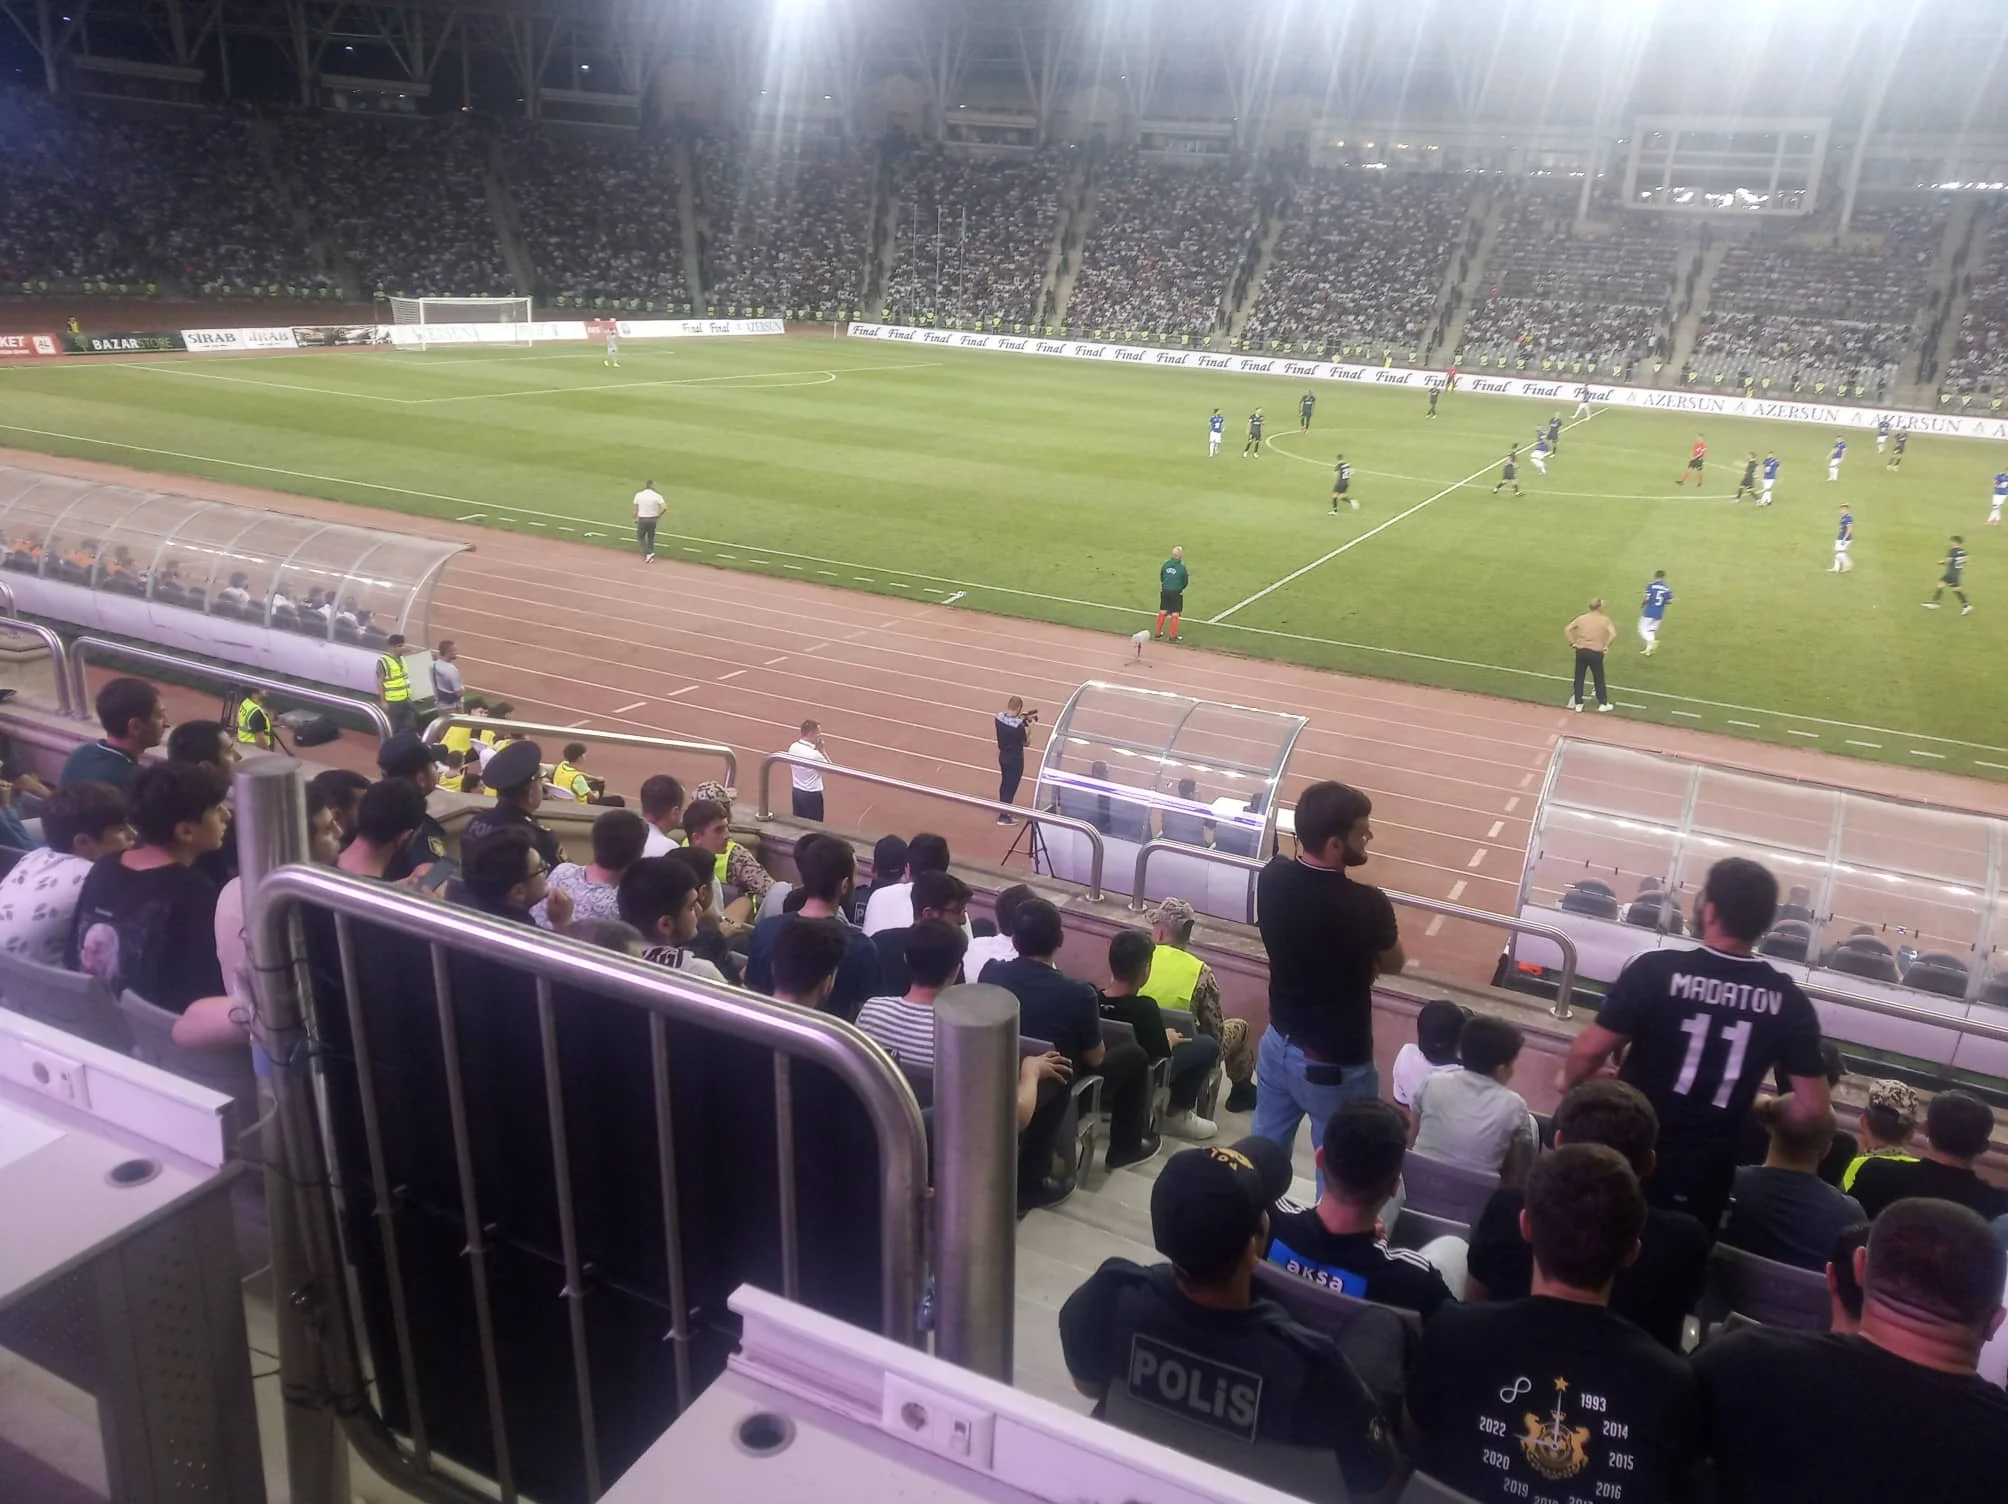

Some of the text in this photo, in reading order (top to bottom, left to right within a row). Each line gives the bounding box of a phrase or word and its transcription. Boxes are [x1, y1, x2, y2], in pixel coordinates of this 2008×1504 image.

[852, 325, 880, 337] Final
[888, 328, 915, 341] Final
[923, 331, 951, 344] Final
[960, 334, 989, 348] Final
[998, 338, 1027, 351] Final
[1035, 342, 1065, 354] Final
[1075, 345, 1105, 358] Final
[1114, 348, 1146, 362] Final
[1156, 351, 1189, 365] Final
[1198, 355, 1231, 368] Final
[1240, 359, 1274, 373] Final
[1284, 362, 1318, 376] Final
[1329, 366, 1365, 380] Final
[1375, 370, 1412, 385] Final
[1472, 378, 1511, 393] Final
[1522, 383, 1562, 397] Final
[1642, 393, 1724, 412] AZERSUN
[1753, 403, 1840, 422] AZERSUN
[1655, 590, 1665, 606] 5
[1669, 972, 1783, 1016] MADATOV
[1672, 1012, 1753, 1109] 11
[1286, 1258, 1344, 1294] aksa
[1581, 1393, 1607, 1412] 1993
[1479, 1416, 1507, 1437] 2022
[1602, 1420, 1629, 1440] 2014
[1483, 1449, 1510, 1470] 2020
[1609, 1452, 1634, 1471] 2015
[1503, 1477, 1529, 1498] 2019
[1596, 1482, 1622, 1499] 2016
